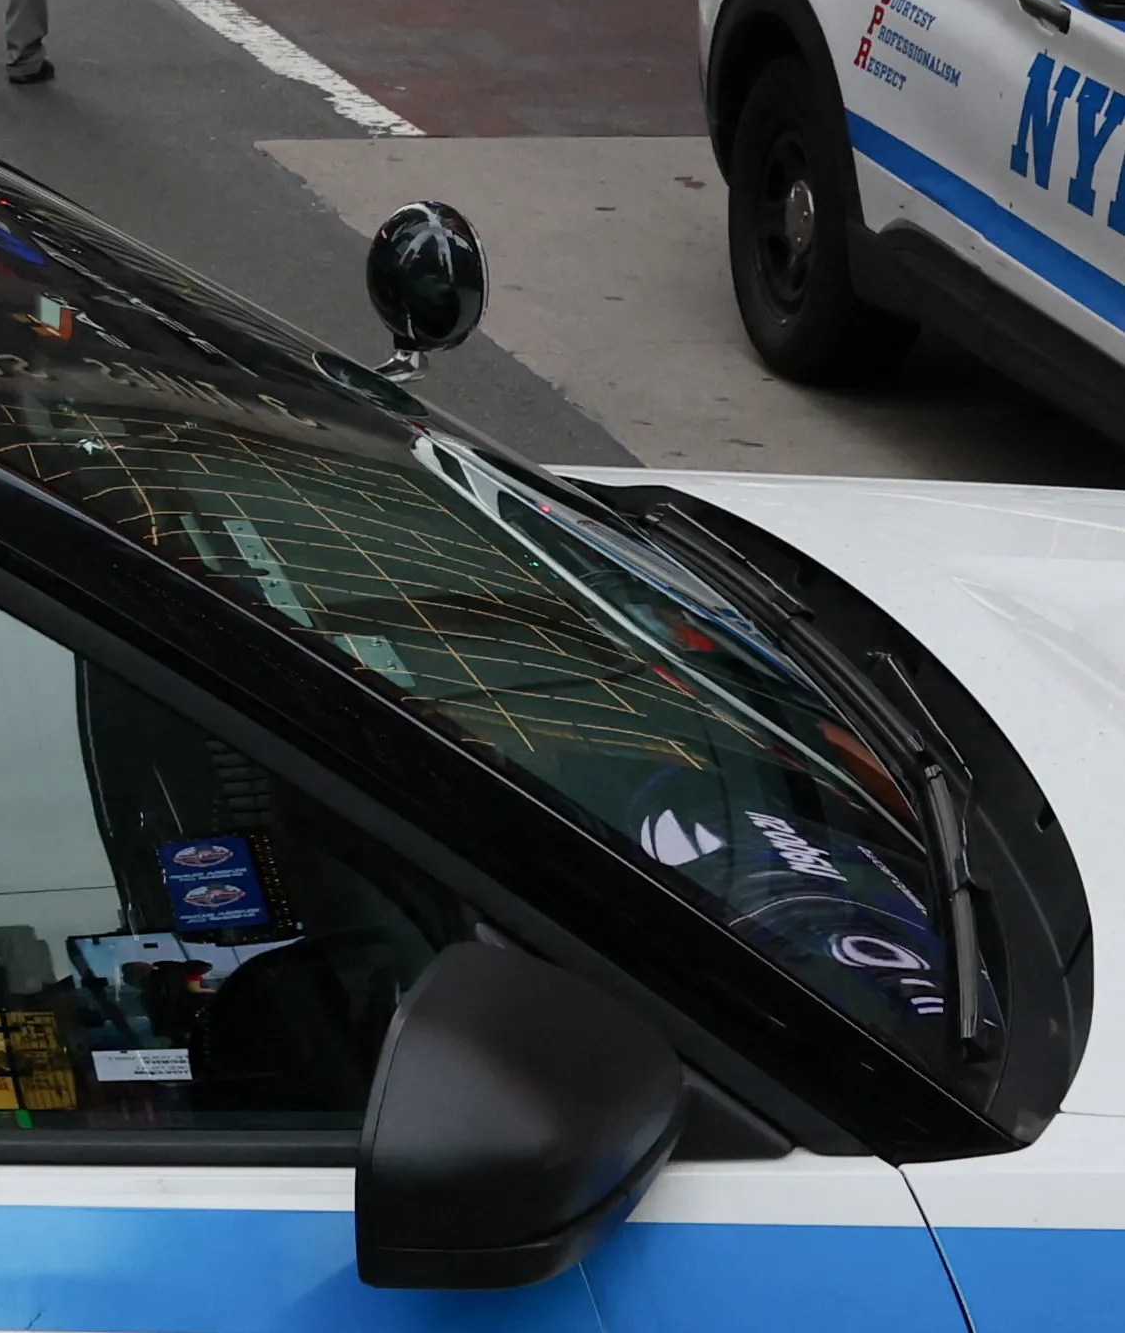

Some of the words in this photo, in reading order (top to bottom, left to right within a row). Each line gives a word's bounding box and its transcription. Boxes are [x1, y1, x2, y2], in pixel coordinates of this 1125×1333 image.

[853, 36, 907, 91] RESPECT
[866, 4, 962, 88] PROFESSIONALISM
[1010, 52, 1125, 238] NY
